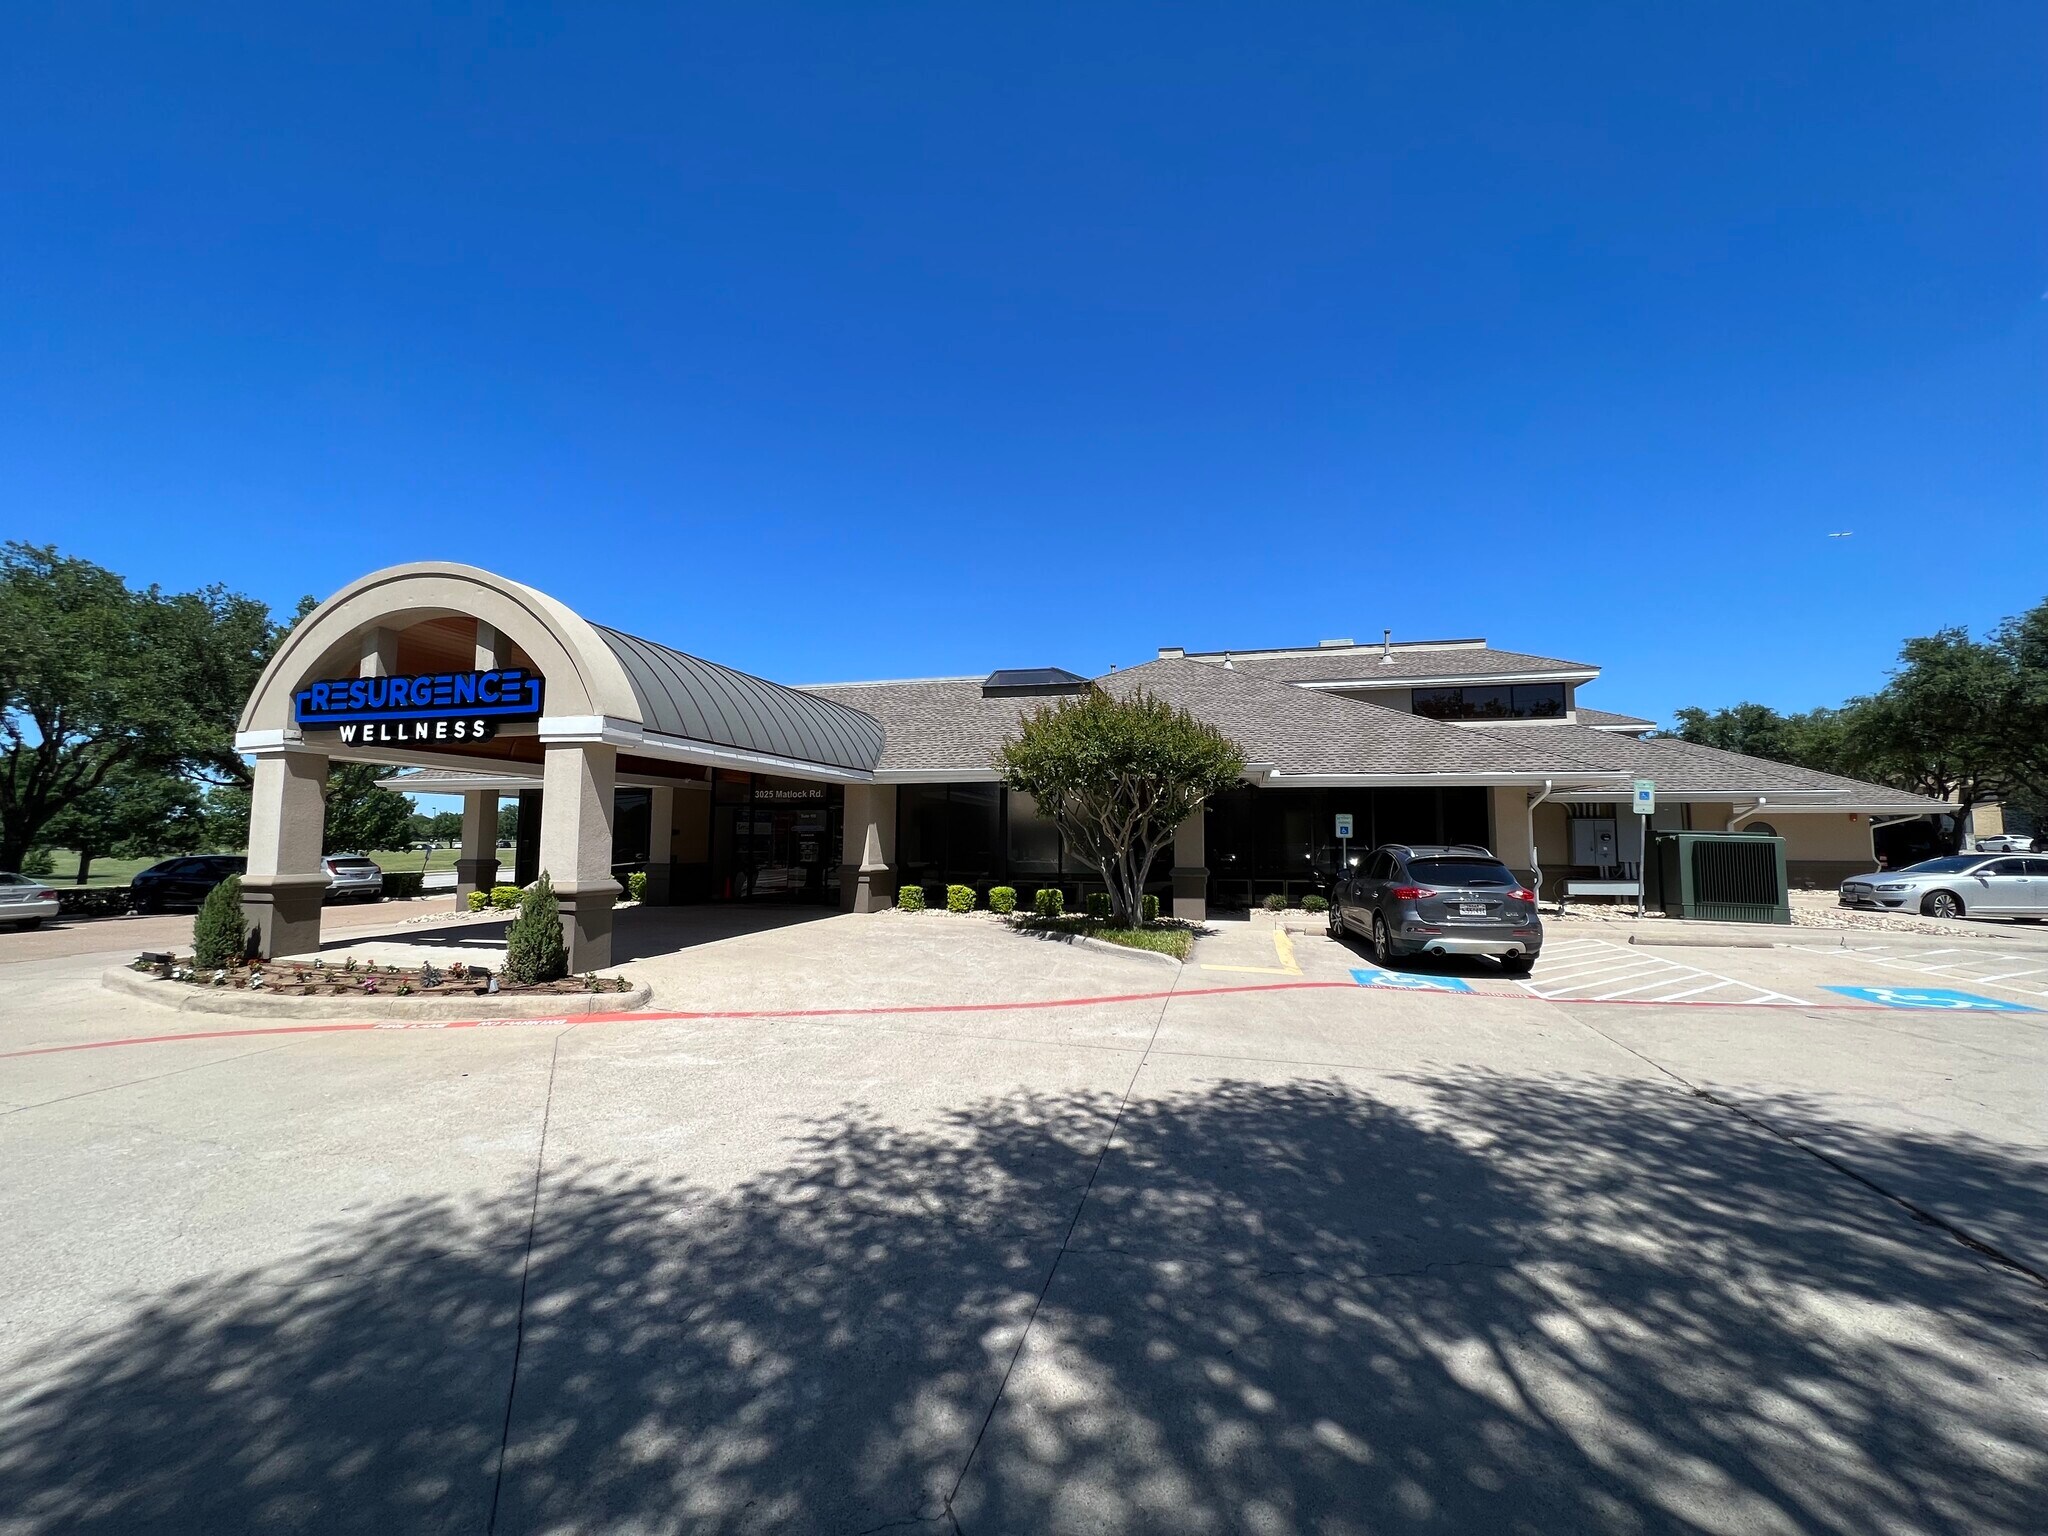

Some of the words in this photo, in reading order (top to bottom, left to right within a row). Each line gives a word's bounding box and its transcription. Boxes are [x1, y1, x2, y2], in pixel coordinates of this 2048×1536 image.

[311, 671, 522, 711] RESURGENCE
[339, 720, 486, 743] WELLNESS
[754, 790, 774, 799] 3025
[775, 790, 807, 799] Matlock
[809, 789, 824, 798] Rd.
